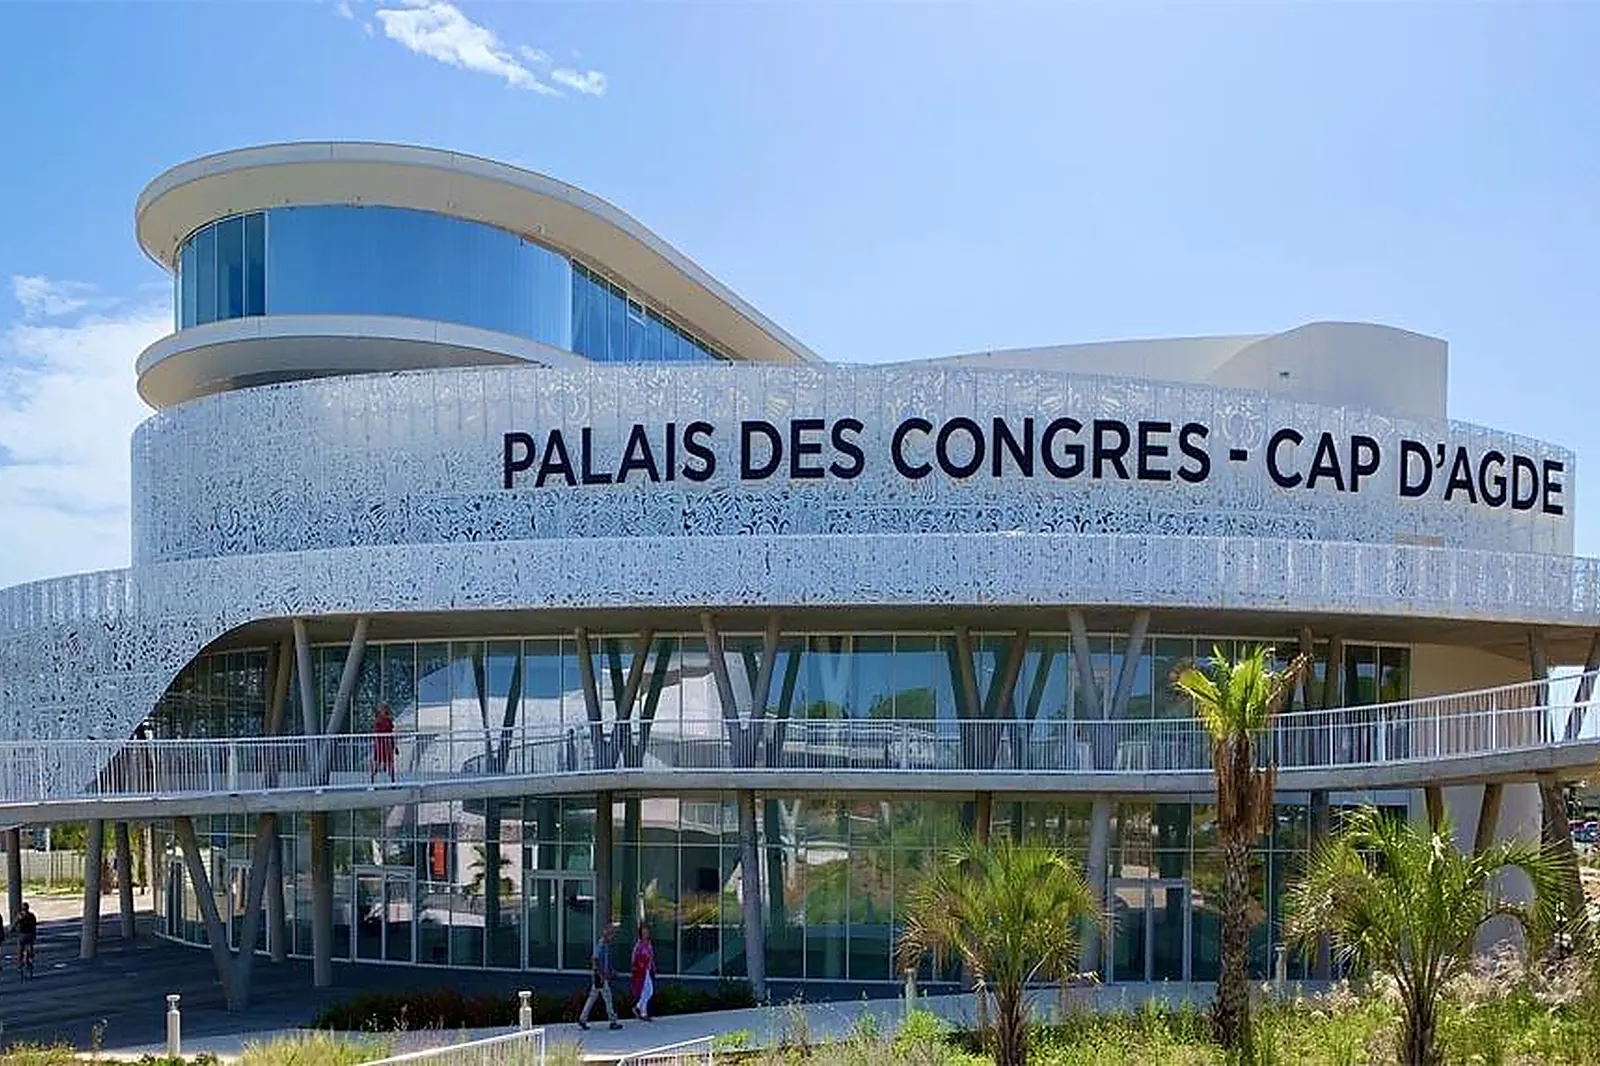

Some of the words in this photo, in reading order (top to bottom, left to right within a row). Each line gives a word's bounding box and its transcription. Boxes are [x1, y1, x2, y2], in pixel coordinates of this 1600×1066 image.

[503, 421, 717, 490] PALAIS
[740, 417, 865, 480] DES
[891, 417, 1211, 483] CONGRES
[1266, 428, 1381, 493] CAP
